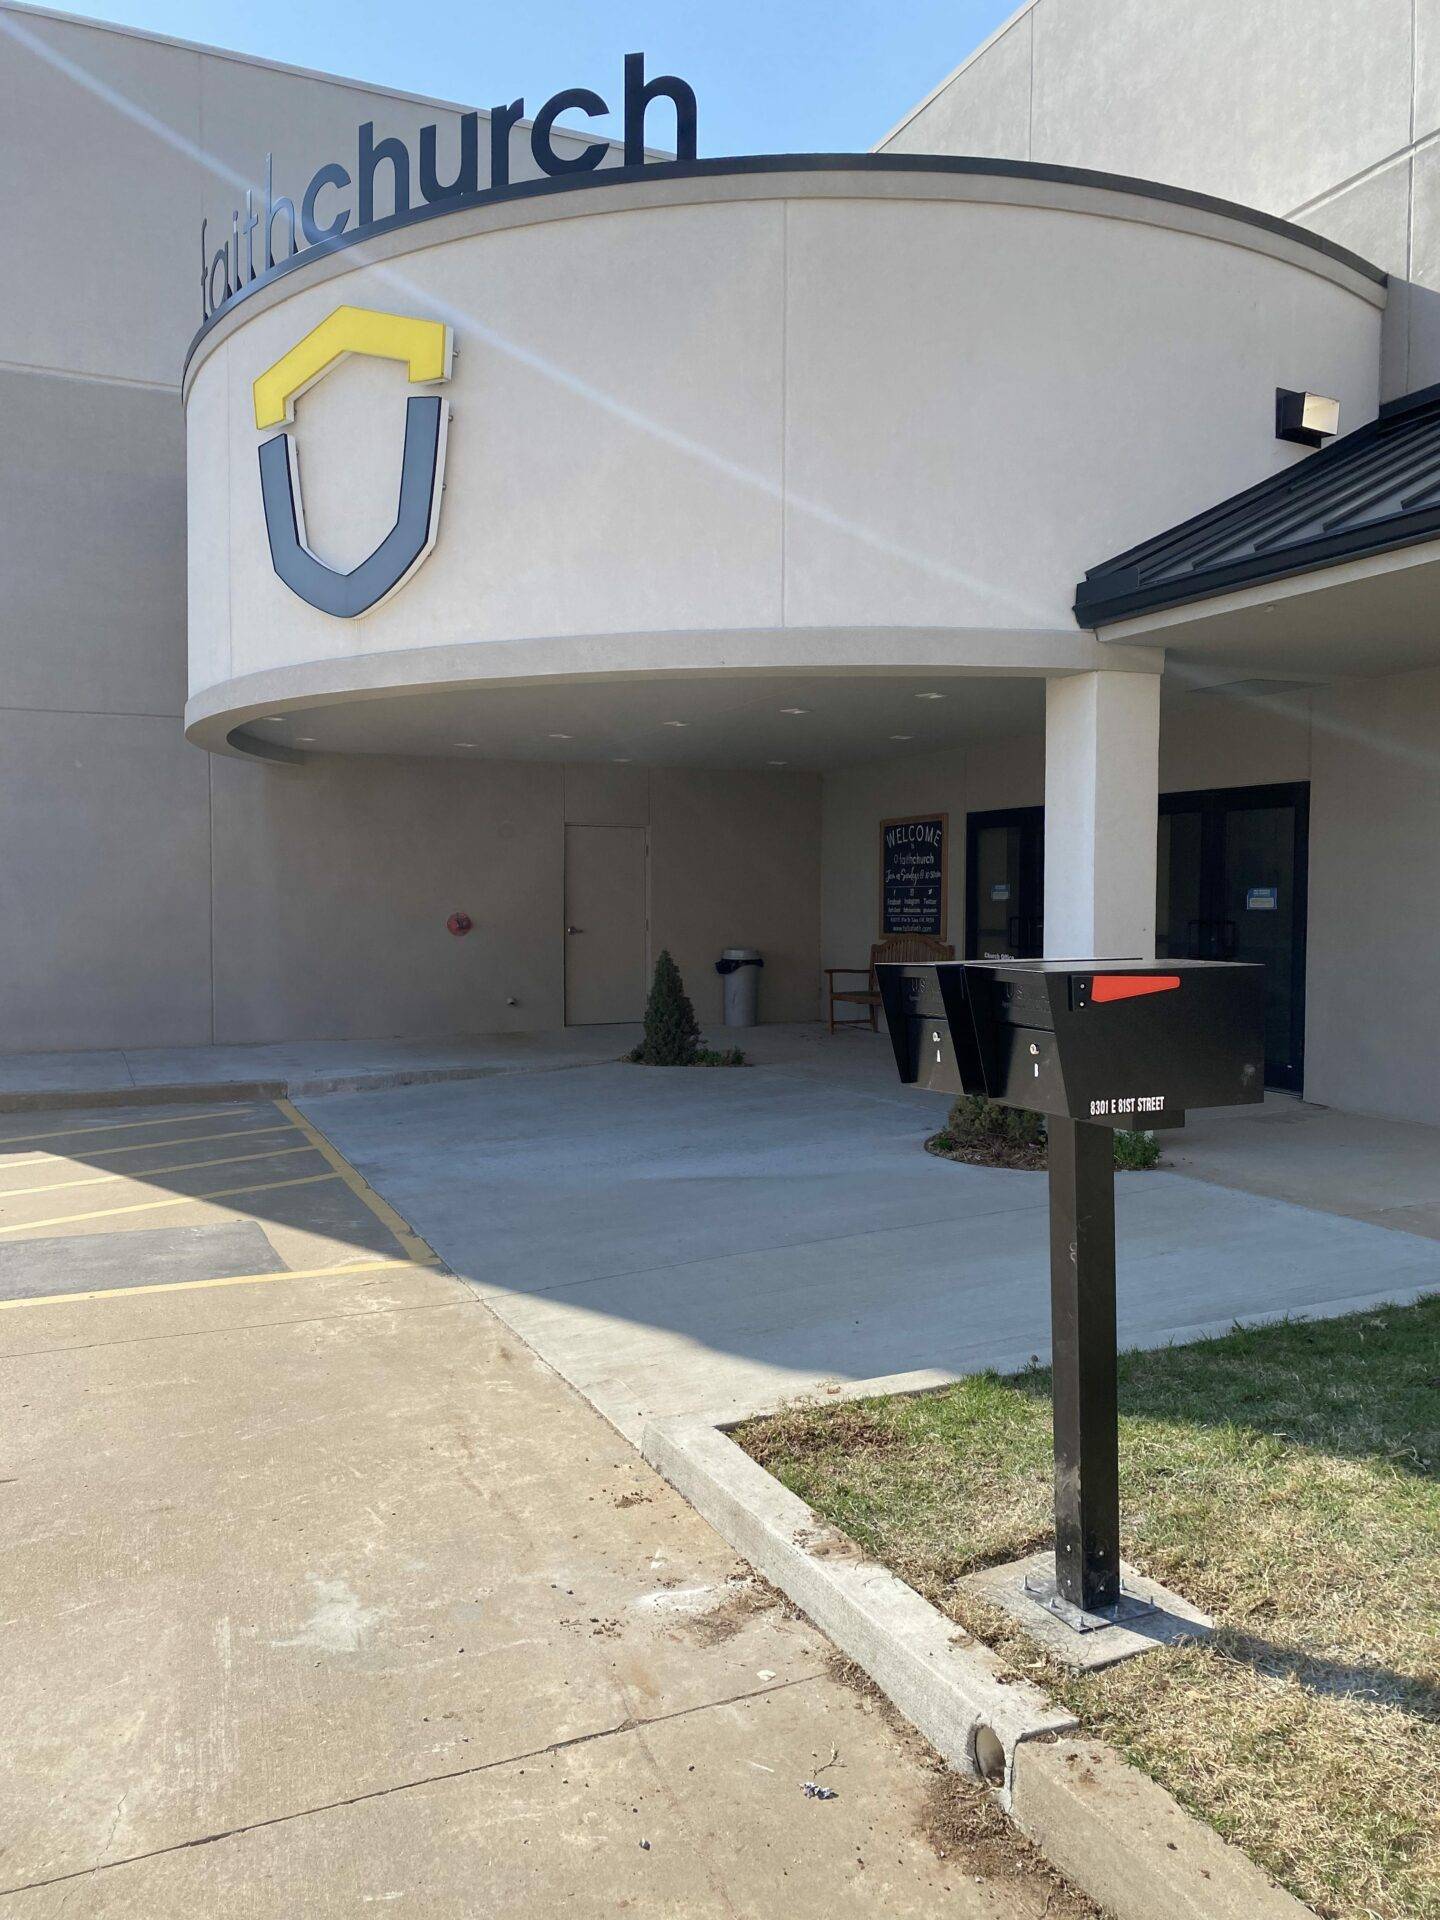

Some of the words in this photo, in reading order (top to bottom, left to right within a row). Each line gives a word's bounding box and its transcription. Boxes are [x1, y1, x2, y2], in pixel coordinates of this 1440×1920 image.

[200, 52, 697, 322] faithchurch
[886, 825, 942, 849] WELCOME
[984, 951, 999, 960] Church
[1090, 1100, 1109, 1116] 8301
[1111, 1099, 1117, 1114] E
[1118, 1097, 1136, 1113] 81ST
[1137, 1096, 1165, 1112] STREET
